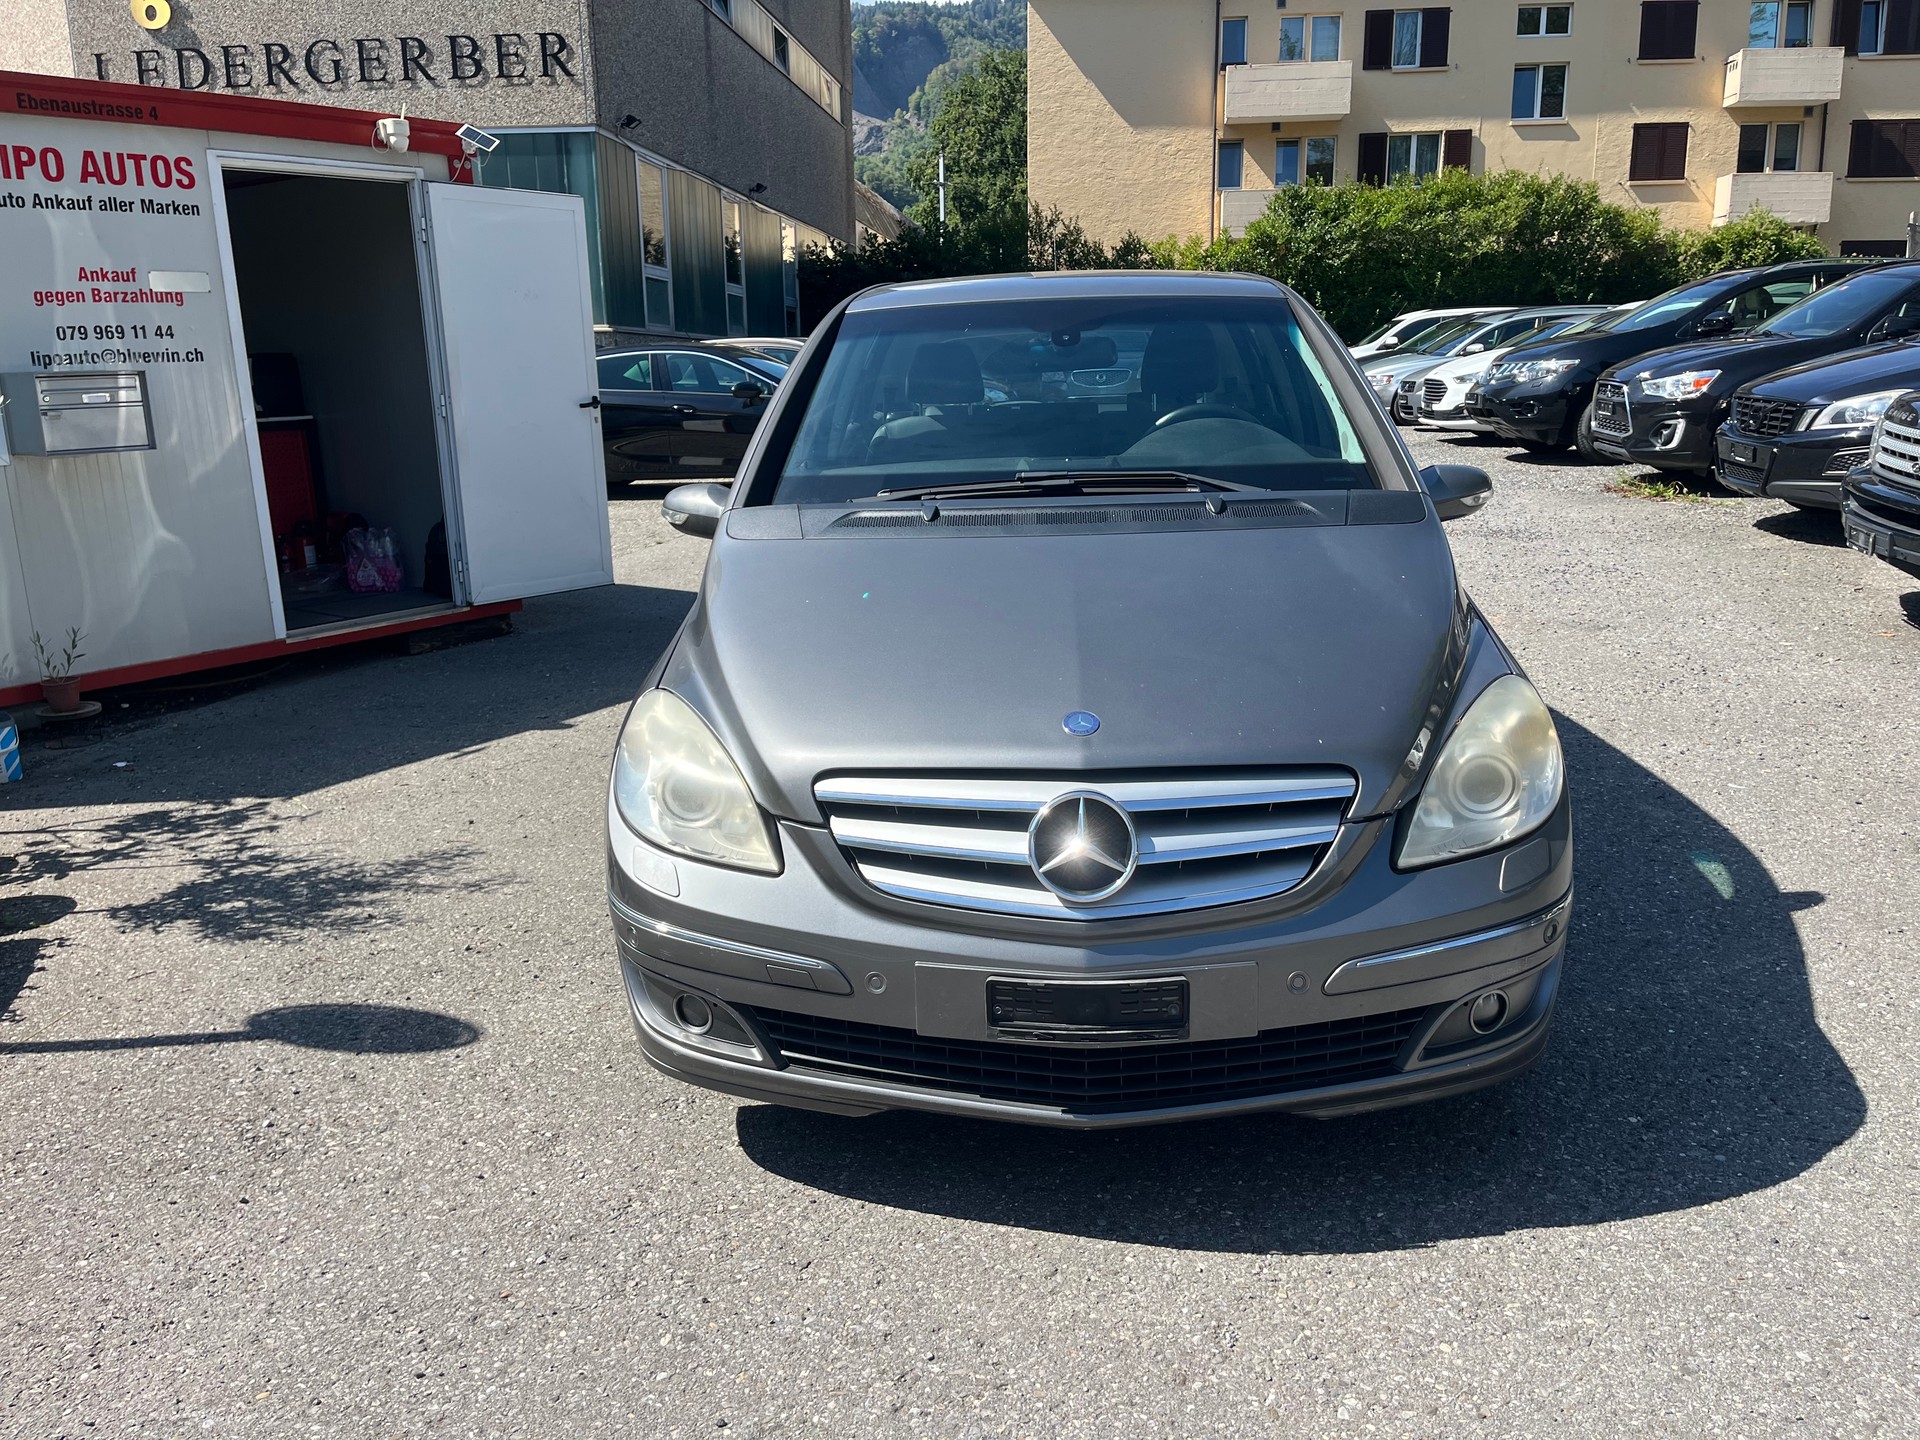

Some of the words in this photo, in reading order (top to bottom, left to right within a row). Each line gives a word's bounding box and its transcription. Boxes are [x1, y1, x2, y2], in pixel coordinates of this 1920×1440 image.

[15, 93, 144, 120] Ebenaustrasse
[149, 107, 159, 121] 4
[80, 150, 197, 190] AUTOS
[32, 193, 93, 211] Ankauf
[98, 196, 135, 213] aller
[140, 198, 201, 217] Marken
[78, 266, 137, 284] Ankauf
[33, 289, 86, 307] gegen
[91, 287, 185, 307] Barzahlung
[56, 325, 88, 341] 079
[93, 325, 125, 341] 969
[131, 325, 147, 340] 11
[154, 325, 175, 340] 44
[30, 348, 205, 370] lipoauto@bluewin.ch
